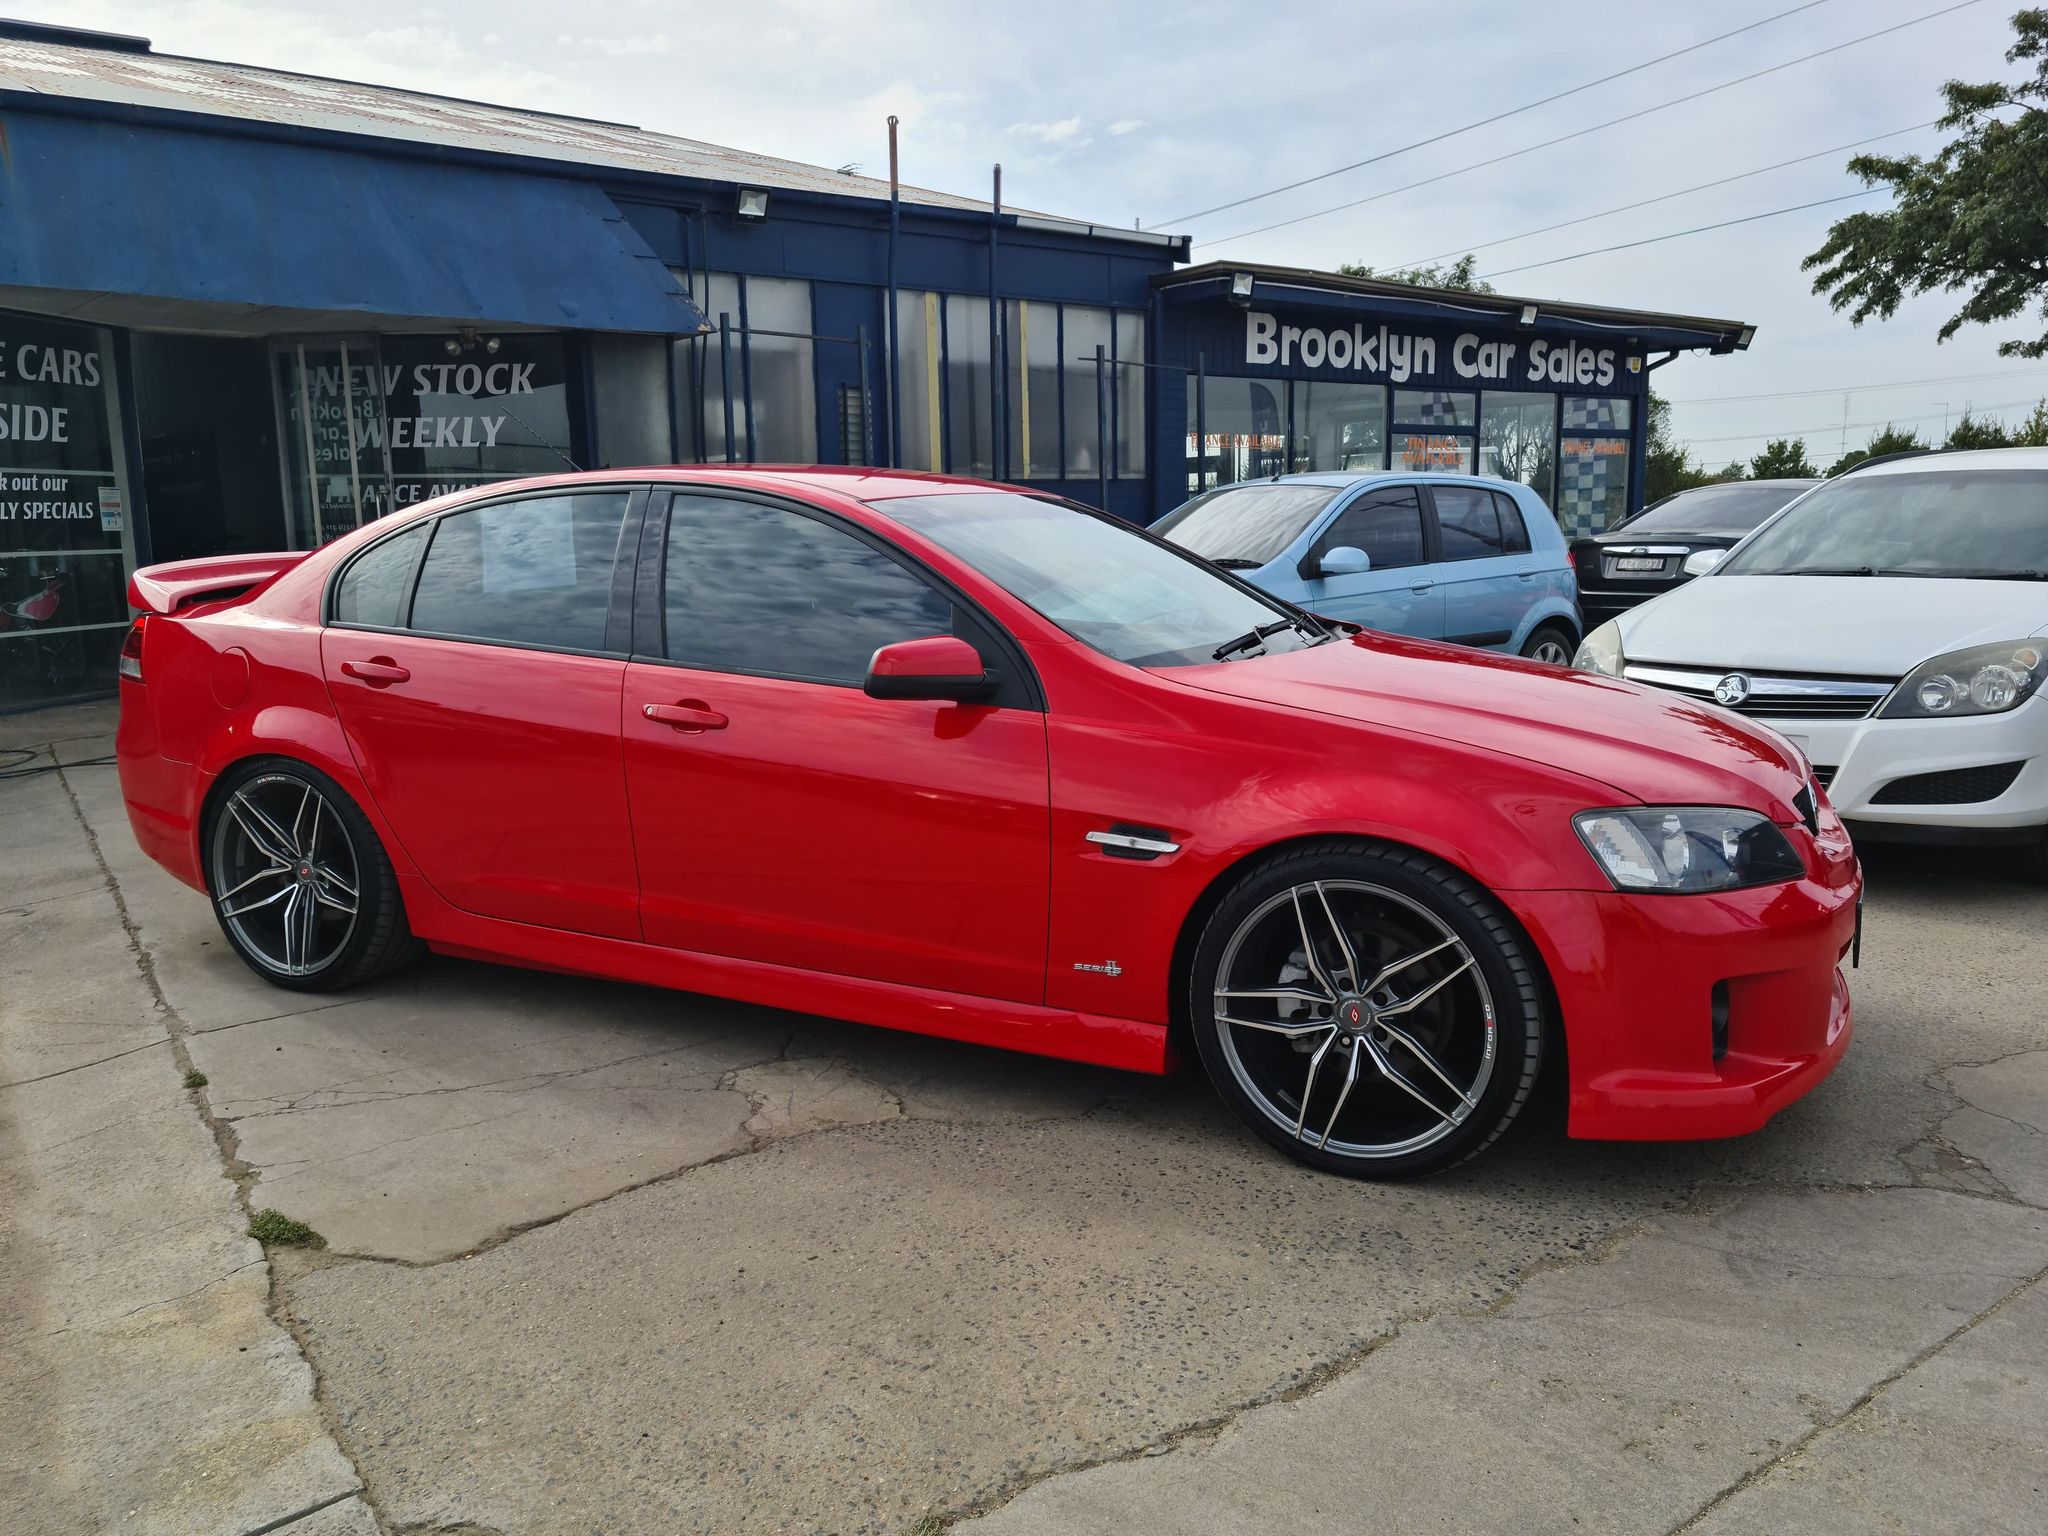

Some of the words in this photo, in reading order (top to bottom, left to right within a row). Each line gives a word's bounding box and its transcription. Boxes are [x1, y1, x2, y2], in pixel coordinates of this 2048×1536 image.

[1246, 312, 1436, 383] Brooklyn
[1452, 333, 1516, 379] Car
[1527, 339, 1615, 387] Sales
[17, 344, 100, 387] CARS
[316, 364, 403, 397] NEW
[413, 363, 537, 396] STOCK
[352, 416, 506, 448] WEEKLY
[1408, 436, 1458, 450] FINANCE
[1402, 451, 1465, 465] AVAILABLE
[11, 474, 38, 491] out
[42, 477, 69, 492] our
[0, 502, 19, 519] LY
[23, 501, 94, 519] SPECIALS
